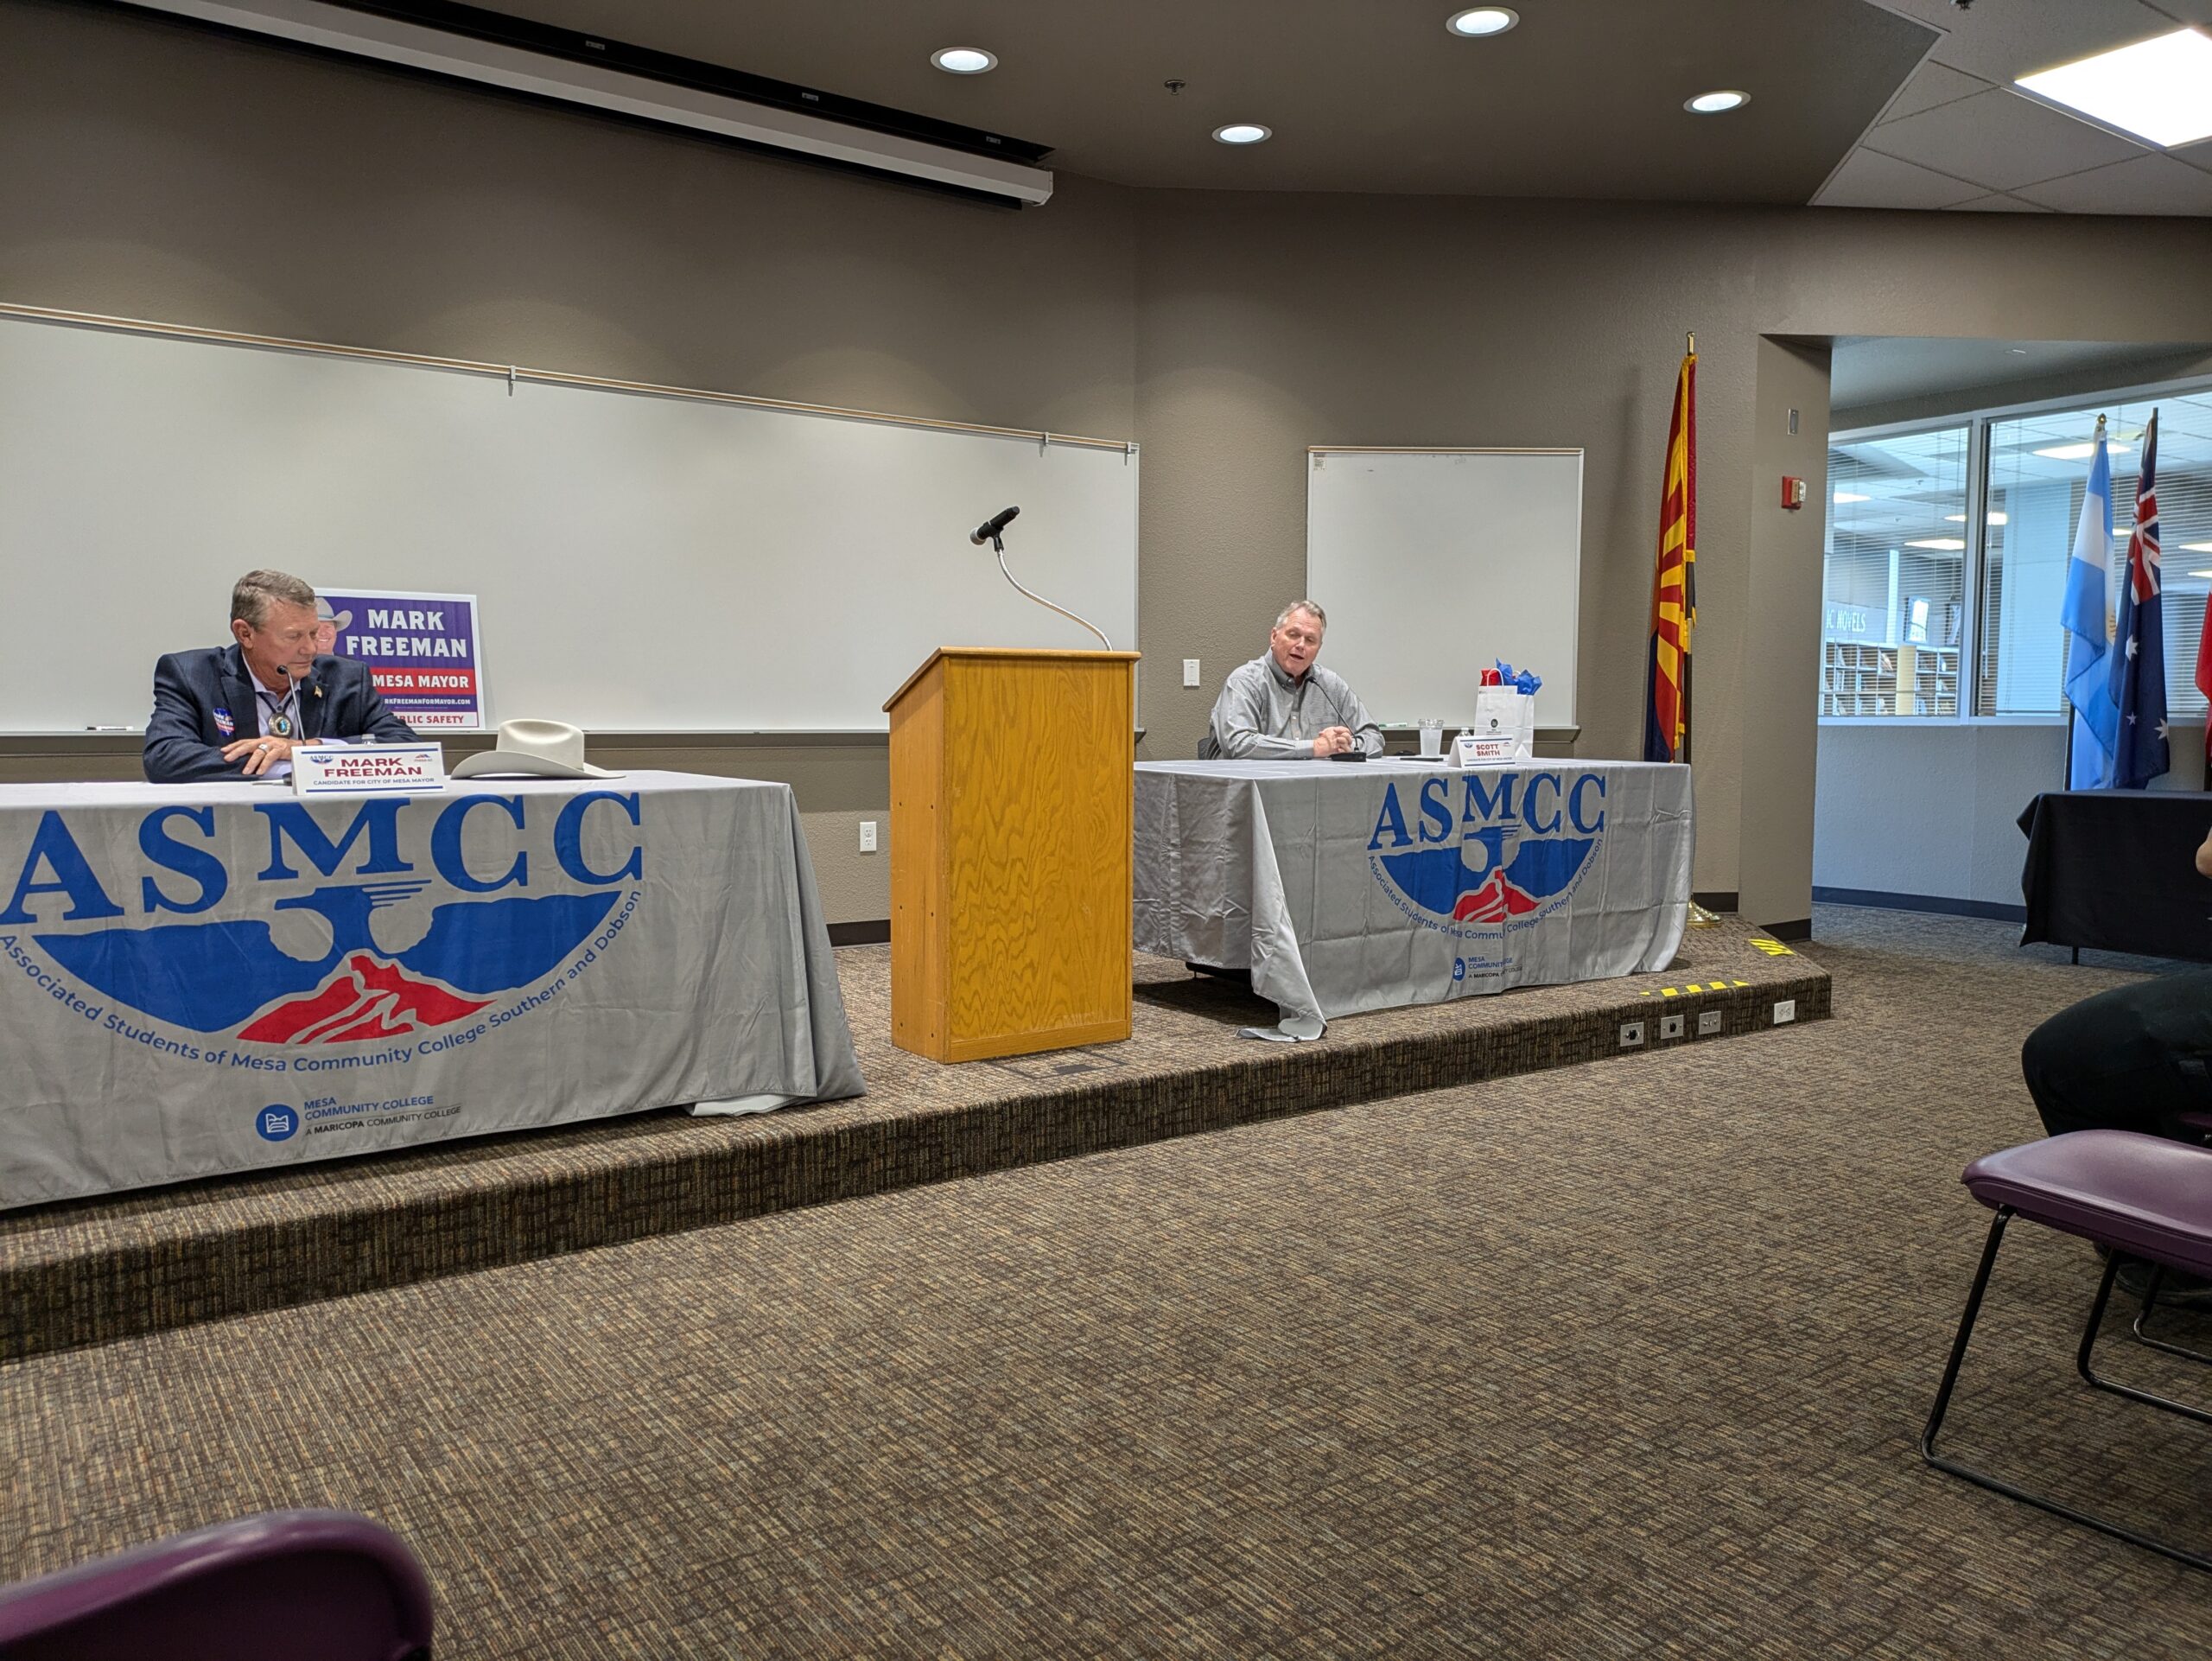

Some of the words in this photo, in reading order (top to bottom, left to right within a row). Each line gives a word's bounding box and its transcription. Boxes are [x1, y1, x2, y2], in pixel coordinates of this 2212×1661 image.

[367, 608, 445, 631] MARK
[1836, 609, 1866, 633] NOVELS
[346, 635, 467, 658] FREEMAN
[372, 674, 414, 688] MESA
[418, 675, 469, 688] MAYOR
[426, 715, 464, 724] SAFETY
[324, 767, 423, 778] FREEMAN
[340, 757, 403, 767] MARK
[1367, 773, 1606, 850] ASMCC
[0, 790, 643, 926] ASMCC
[1369, 856, 1402, 907] Associated
[1400, 902, 1439, 930] Students
[1573, 875, 1583, 894] and
[1581, 838, 1603, 876] Dobson
[1468, 961, 1504, 970] COMMUNIT
[0, 934, 104, 1021] Associated
[104, 1013, 200, 1060] Students
[205, 1048, 226, 1066] of
[231, 1052, 287, 1072] Mesa
[293, 1046, 413, 1072] Community
[418, 1022, 486, 1055] College
[489, 977, 566, 1028] Southern
[567, 949, 597, 980] and
[594, 889, 642, 951] Dobson
[304, 1097, 337, 1111] MESA
[304, 1103, 379, 1121] COMMUNITY
[382, 1095, 435, 1111] COLLEGE
[314, 1120, 365, 1135] MARICOPA
[366, 1113, 422, 1128] COMMUNITY
[423, 1106, 461, 1120] COLLEGE
